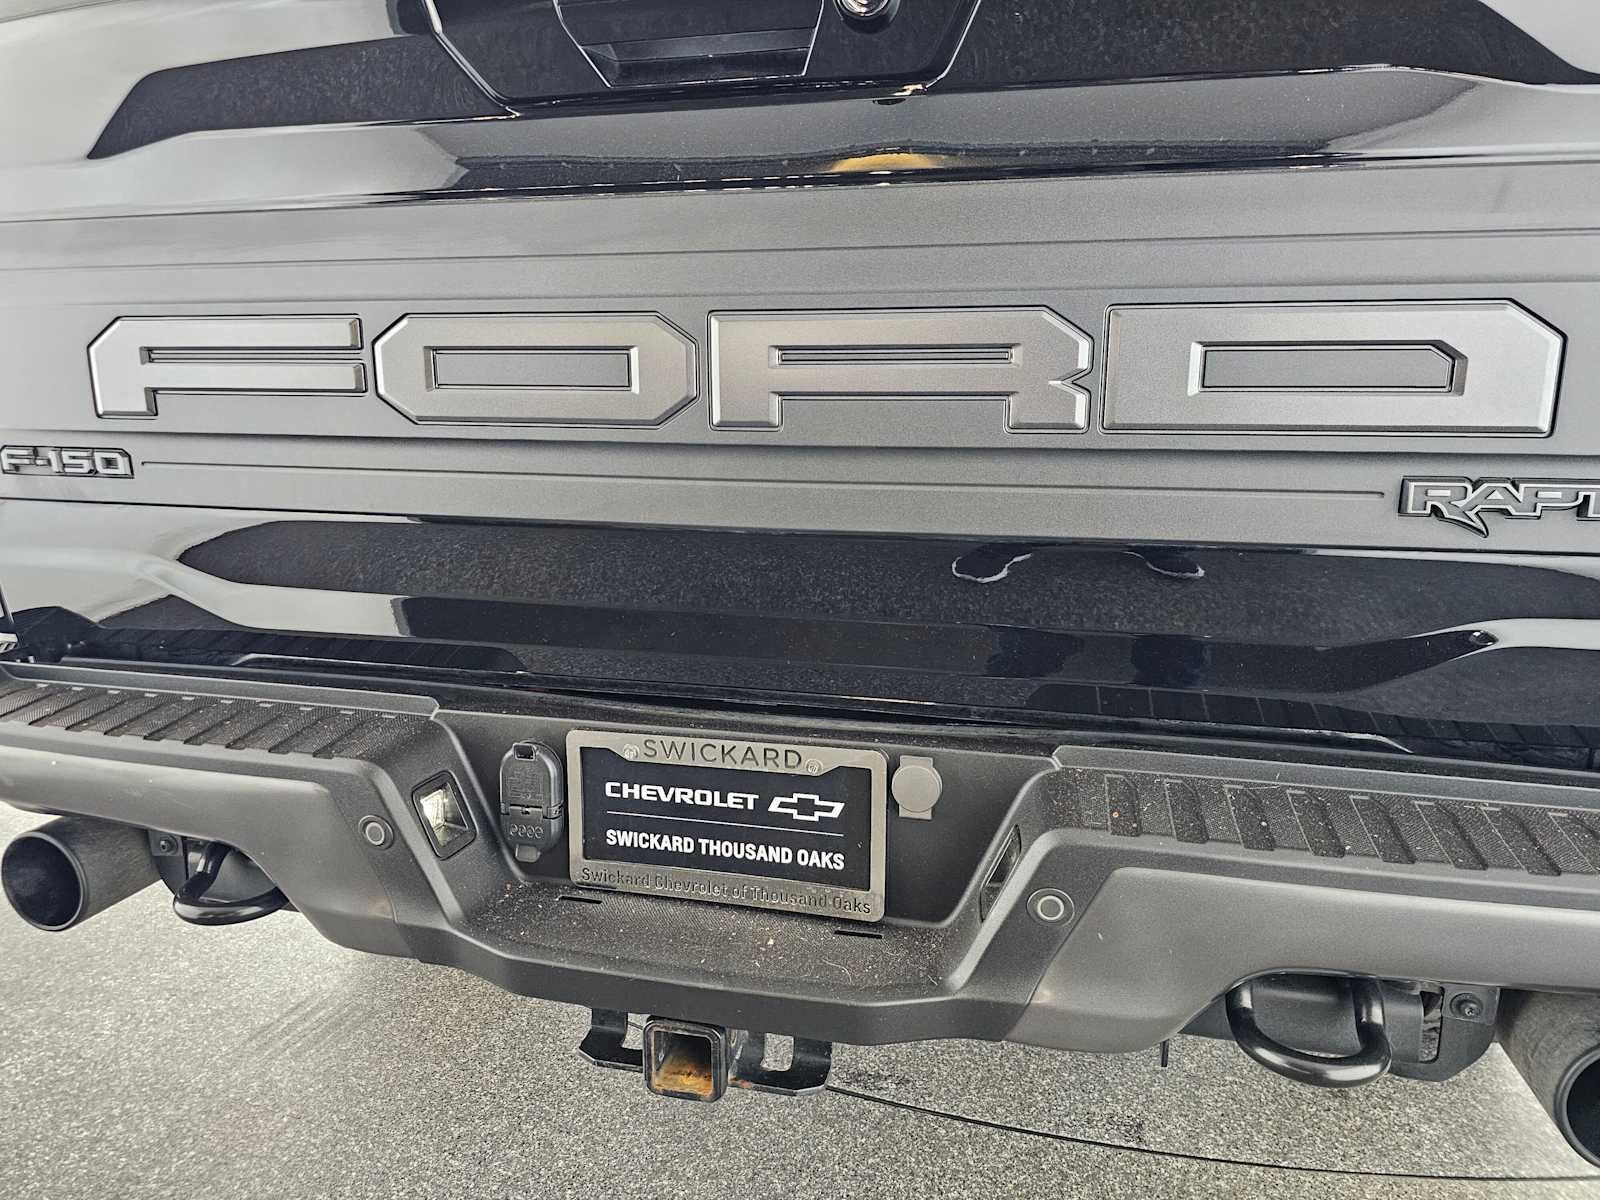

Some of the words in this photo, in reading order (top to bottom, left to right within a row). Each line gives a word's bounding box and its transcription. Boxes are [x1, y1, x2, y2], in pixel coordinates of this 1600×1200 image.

[88, 298, 1567, 436] FORD
[0, 446, 133, 479] F-150
[643, 738, 802, 770] SWICKARD
[604, 781, 759, 810] CHEVROLET
[605, 829, 695, 854] SWICKARD
[698, 838, 793, 864] THOUSAND
[797, 849, 845, 871] OAKS
[581, 866, 651, 889] Swickard
[654, 875, 728, 898] Chevrolet
[732, 885, 748, 899] of
[750, 886, 829, 908] Thousand
[832, 896, 872, 914] Oaks
